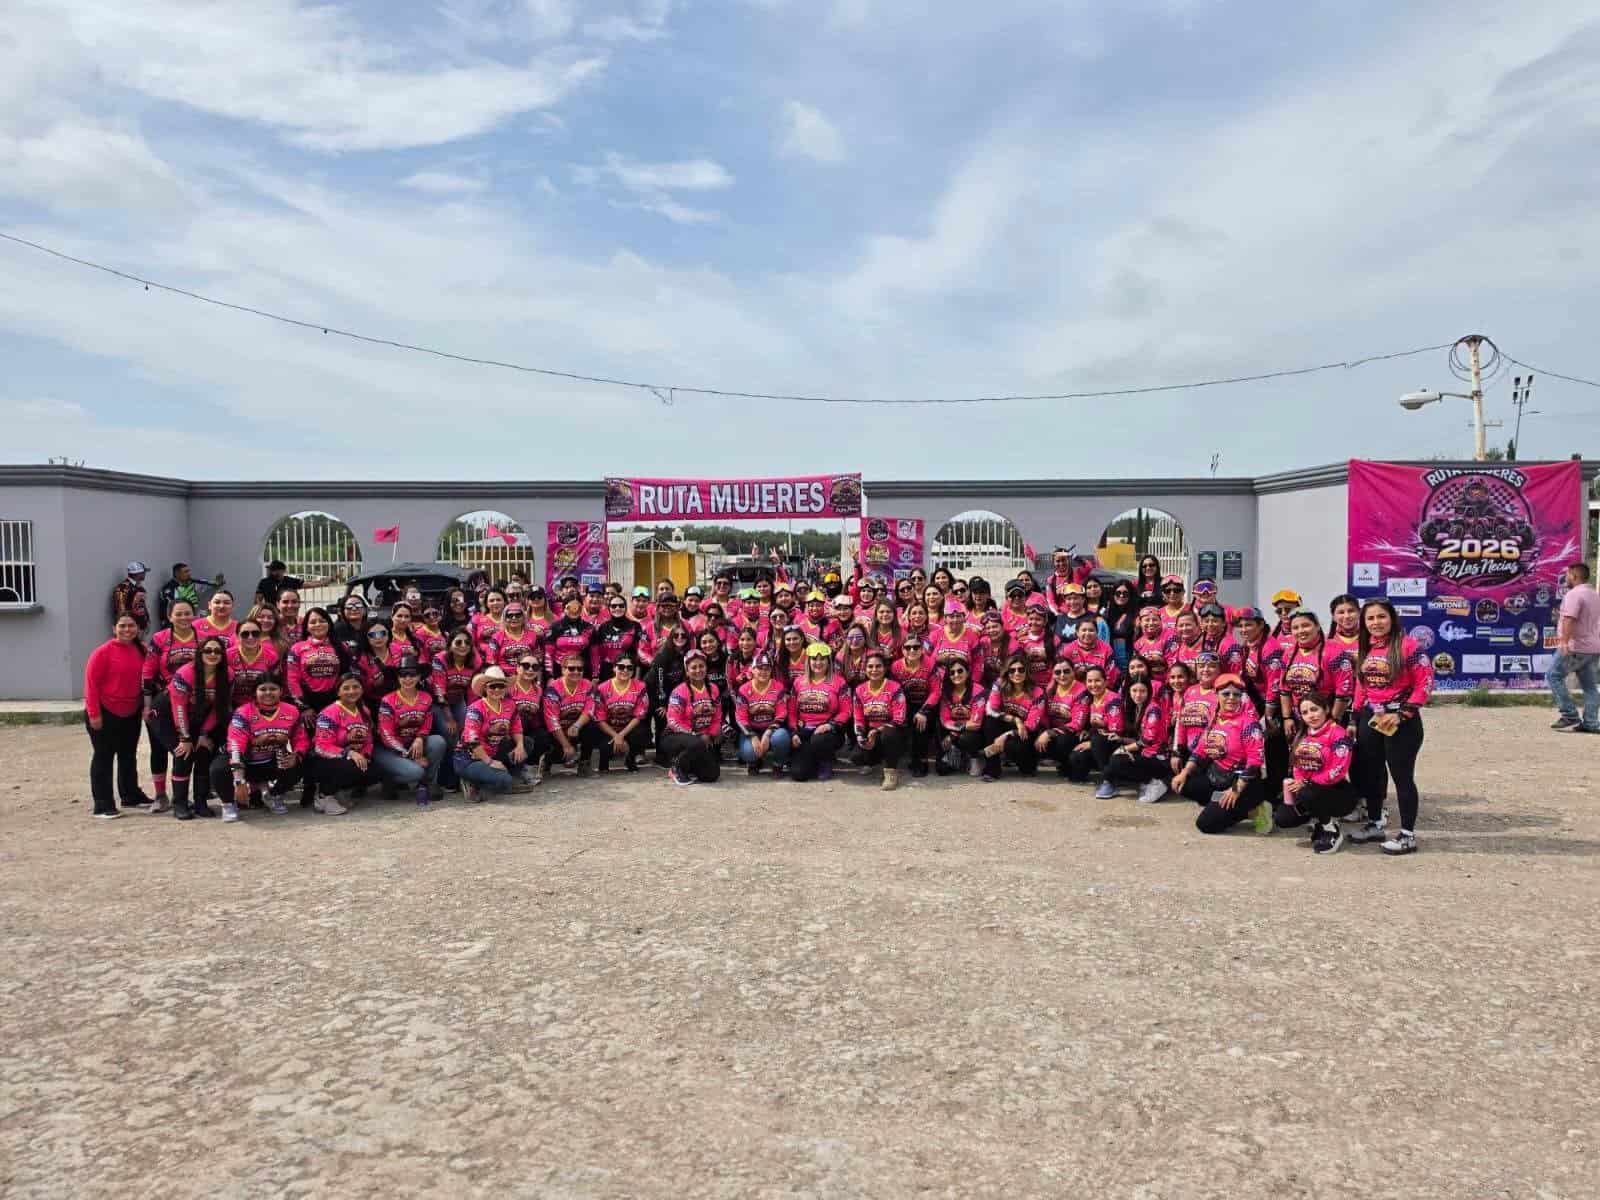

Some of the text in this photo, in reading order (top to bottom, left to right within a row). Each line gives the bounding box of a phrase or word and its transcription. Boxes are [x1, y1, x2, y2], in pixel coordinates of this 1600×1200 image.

[639, 482, 825, 515] RUTA MUJERES
[1438, 539, 1521, 560] 2026
